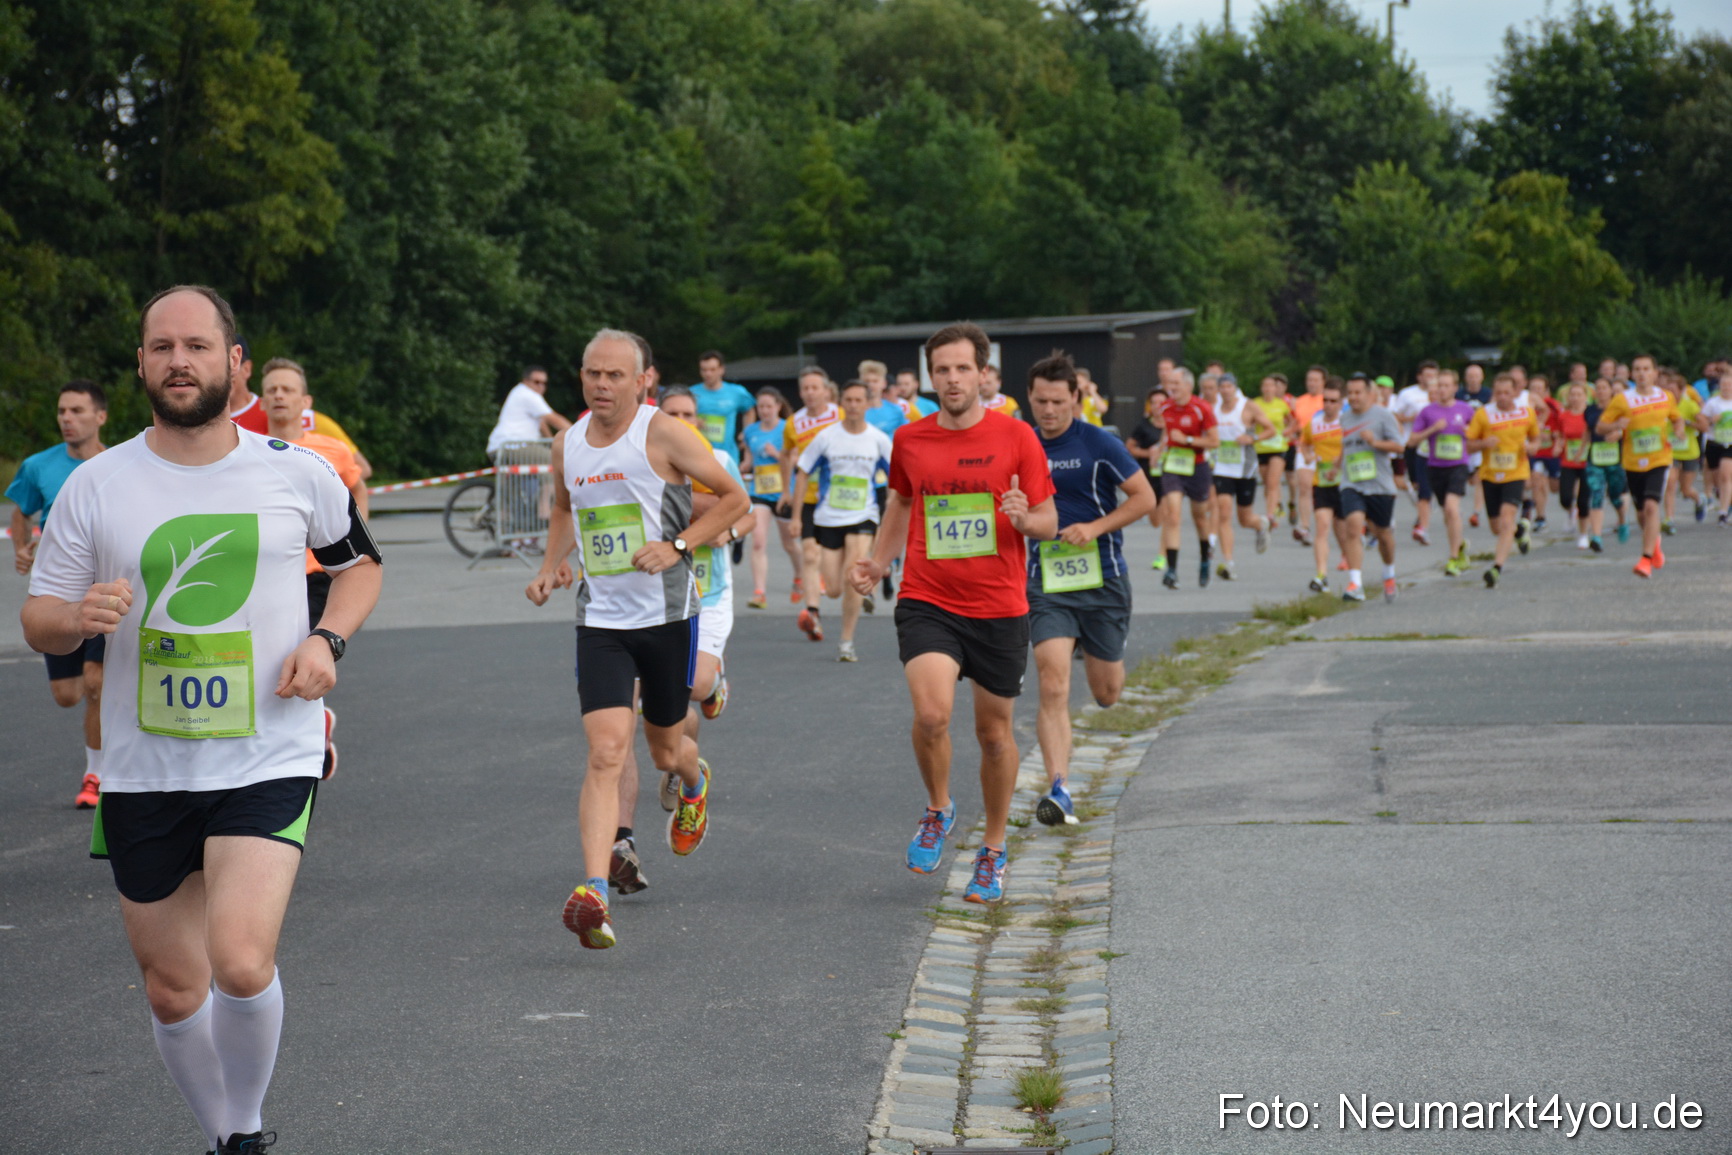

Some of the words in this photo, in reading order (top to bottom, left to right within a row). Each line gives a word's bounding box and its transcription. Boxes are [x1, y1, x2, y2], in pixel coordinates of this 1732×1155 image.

[293, 446, 336, 478] Bionorica
[1053, 459, 1081, 469] POLES
[588, 472, 628, 484] KLEBL
[933, 519, 988, 541] 1479
[592, 531, 628, 556] 591
[1054, 558, 1089, 577] 353
[160, 674, 228, 709] 100
[174, 716, 187, 724] Jan
[188, 717, 210, 725] Seibel
